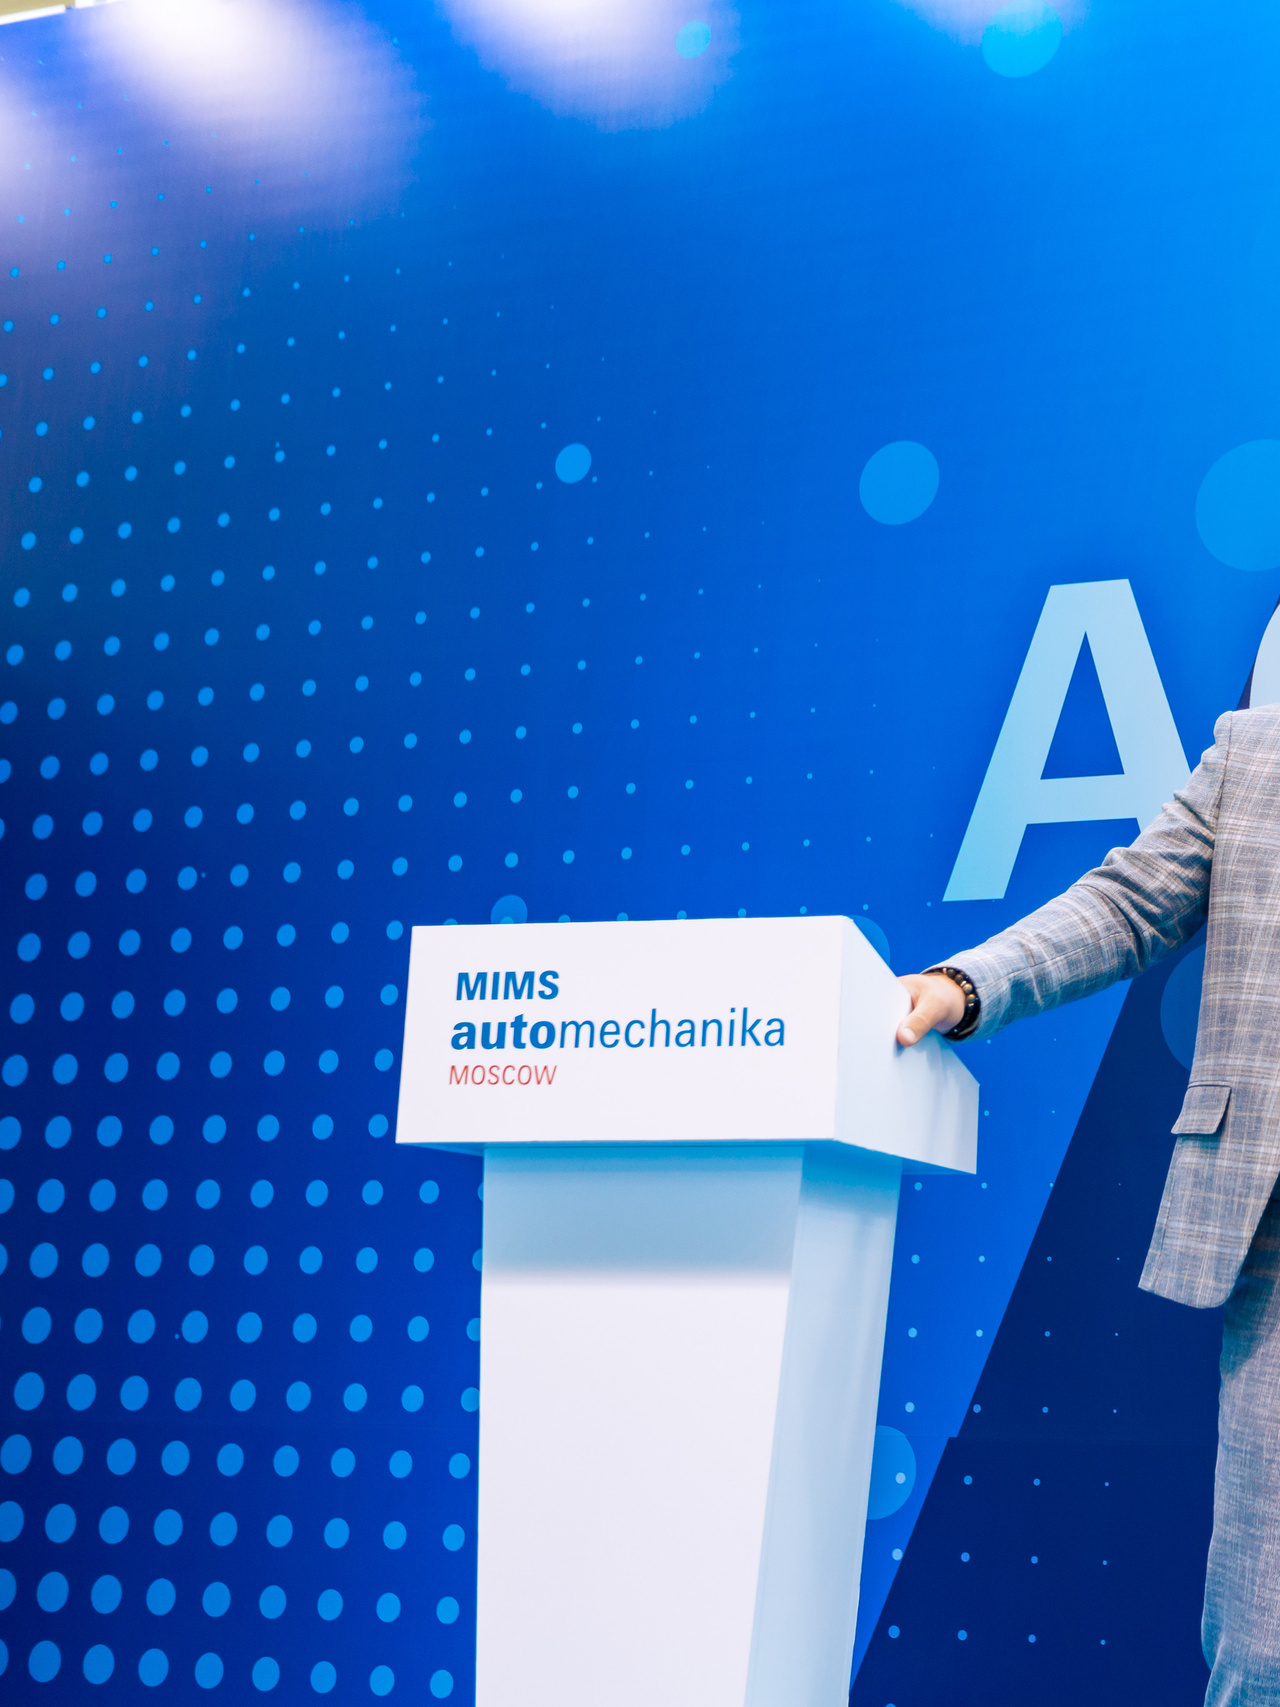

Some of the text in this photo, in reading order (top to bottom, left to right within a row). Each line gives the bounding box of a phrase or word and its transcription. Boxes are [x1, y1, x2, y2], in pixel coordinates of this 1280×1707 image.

[456, 970, 560, 1001] MIMS
[450, 1006, 786, 1050] automechanika
[448, 1064, 558, 1086] MOSCOW
